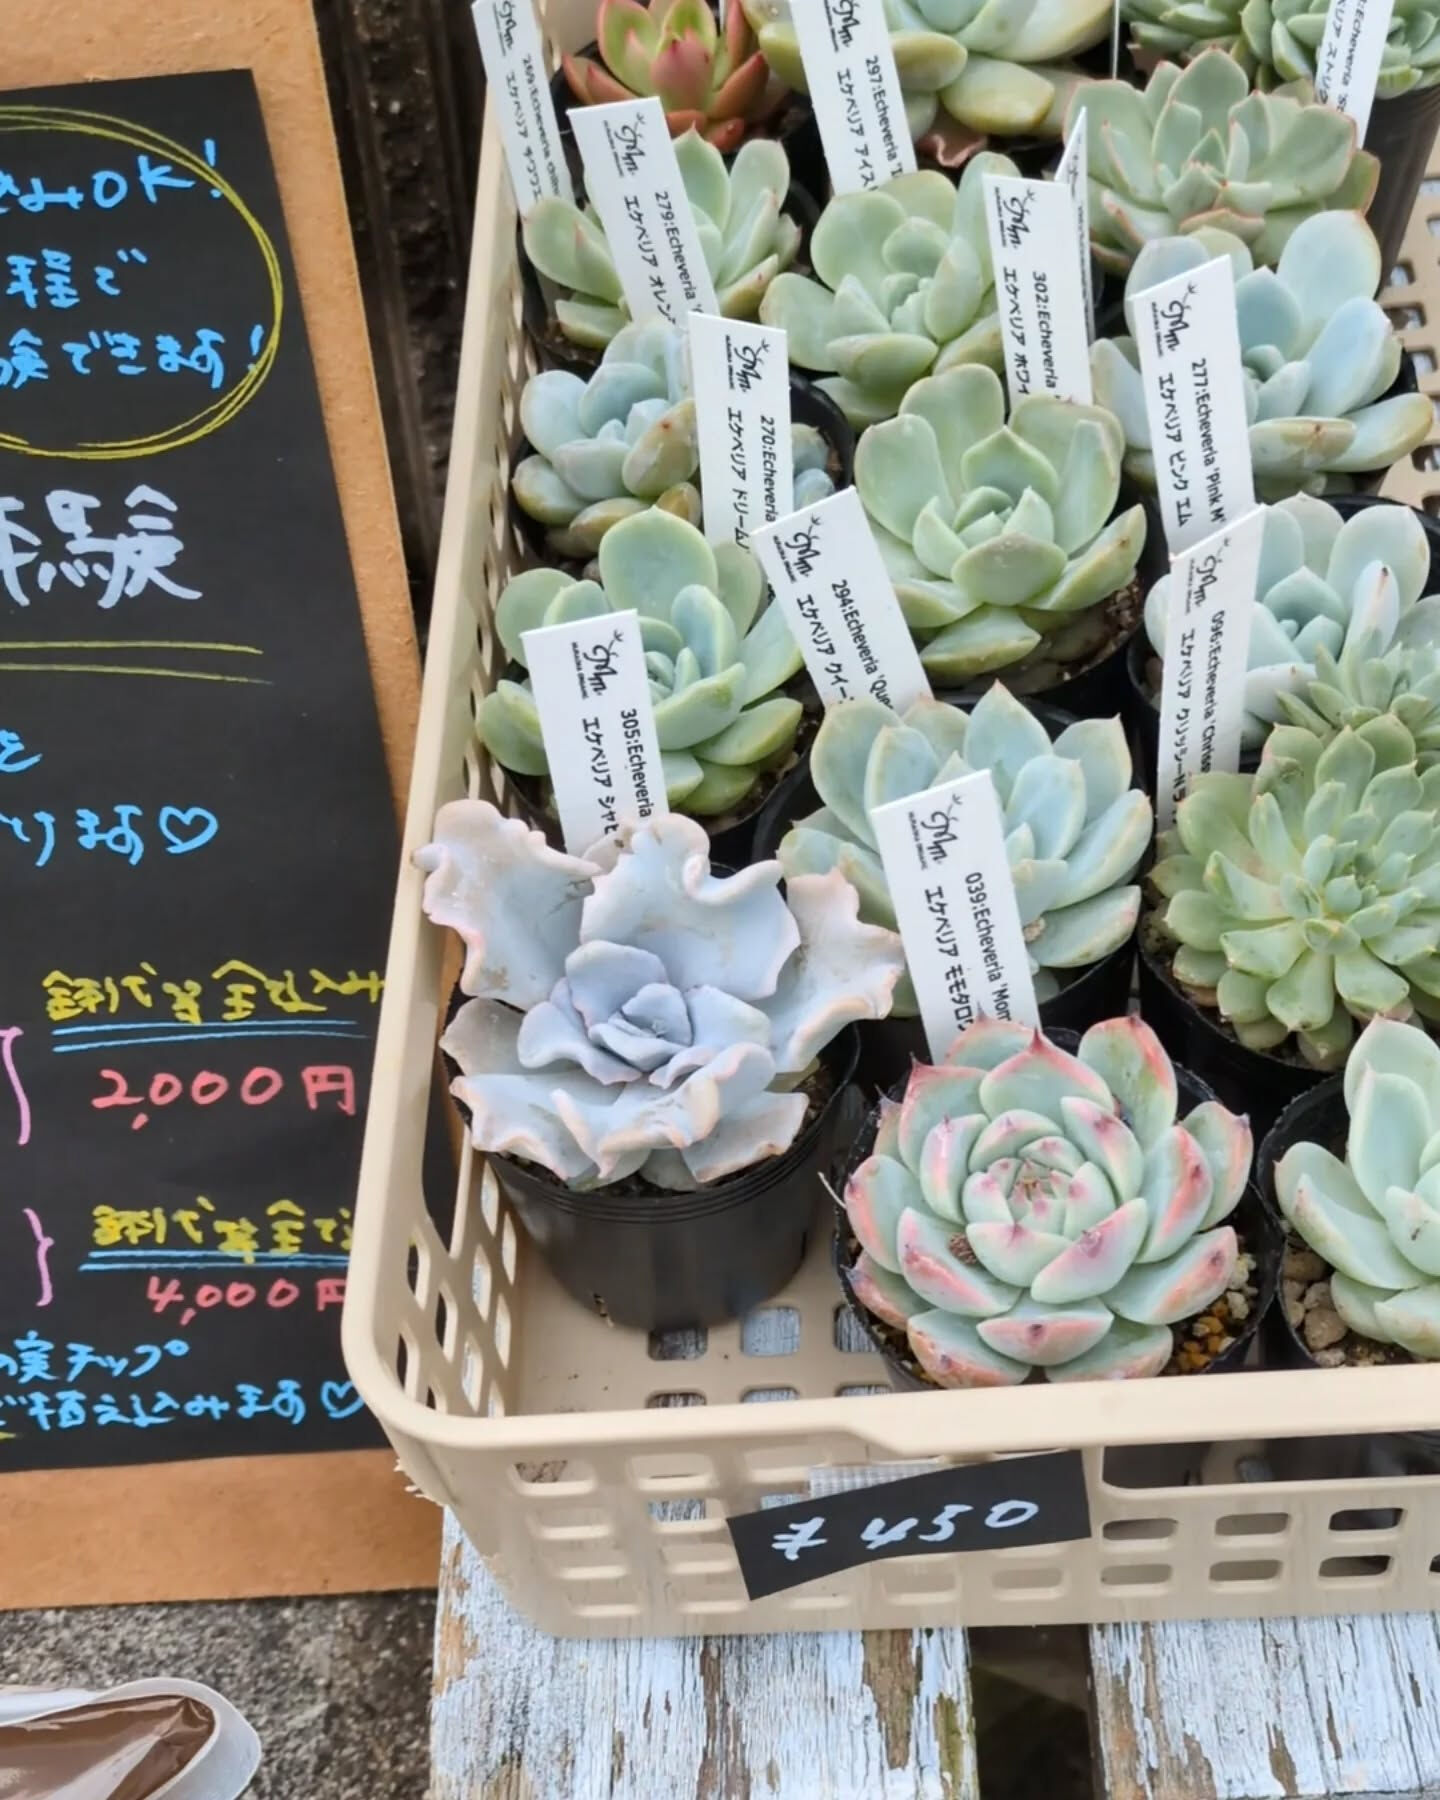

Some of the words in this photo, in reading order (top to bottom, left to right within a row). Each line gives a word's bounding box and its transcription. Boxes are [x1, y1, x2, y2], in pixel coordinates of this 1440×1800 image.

[837, 68, 865, 137] エケベリア
[865, 55, 898, 162] 297:Echeveria
[624, 194, 659, 268] エケベリア
[654, 190, 697, 301] 279:Echeveria
[1003, 266, 1026, 347] エケベリア
[1032, 270, 1060, 390] 302:Echeveria
[727, 406, 748, 482] エケベリア
[1158, 371, 1184, 445] エケベリア
[1191, 358, 1216, 468] 277:Echeveria
[760, 414, 777, 524] 270:Echeveria
[796, 593, 836, 656] エケベリア
[831, 578, 880, 675] 294:Echeveria
[1177, 628, 1196, 702] エケベリア
[582, 716, 613, 789] エケベリア
[620, 708, 655, 818] 305:Echeveria
[924, 885, 960, 958] エケベリア
[964, 871, 1002, 983] 039:Echeveria
[92, 1066, 356, 1130] 2,000円
